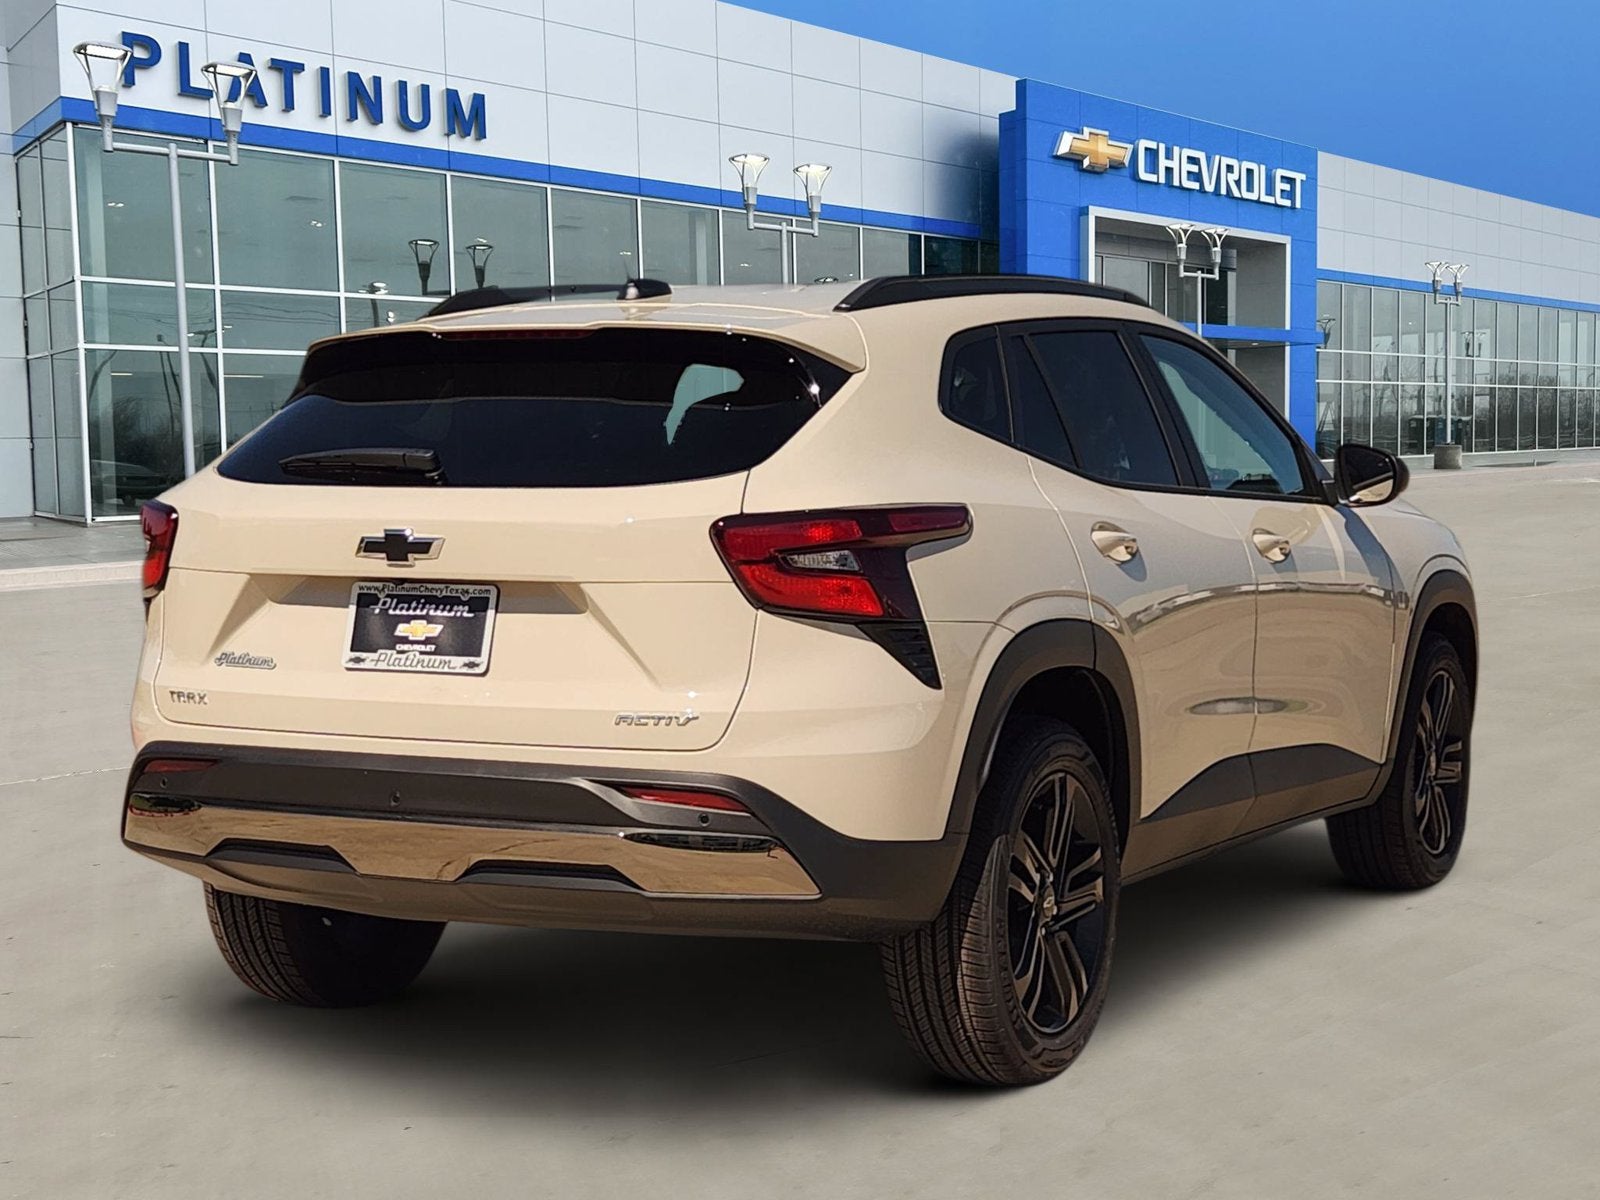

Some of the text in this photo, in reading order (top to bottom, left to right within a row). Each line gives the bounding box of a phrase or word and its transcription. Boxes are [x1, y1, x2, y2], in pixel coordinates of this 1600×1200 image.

[119, 31, 488, 141] PLATINUM
[1135, 139, 1306, 208] CHEVROLET
[358, 583, 491, 597] www.PlatinumChevyTexas.com
[370, 597, 474, 618] Platinum
[395, 643, 436, 652] CHEVROLET
[214, 651, 277, 670] Platinum
[370, 652, 457, 671] Platinum
[169, 690, 207, 705] TRAX
[615, 714, 699, 727] ACTIV
